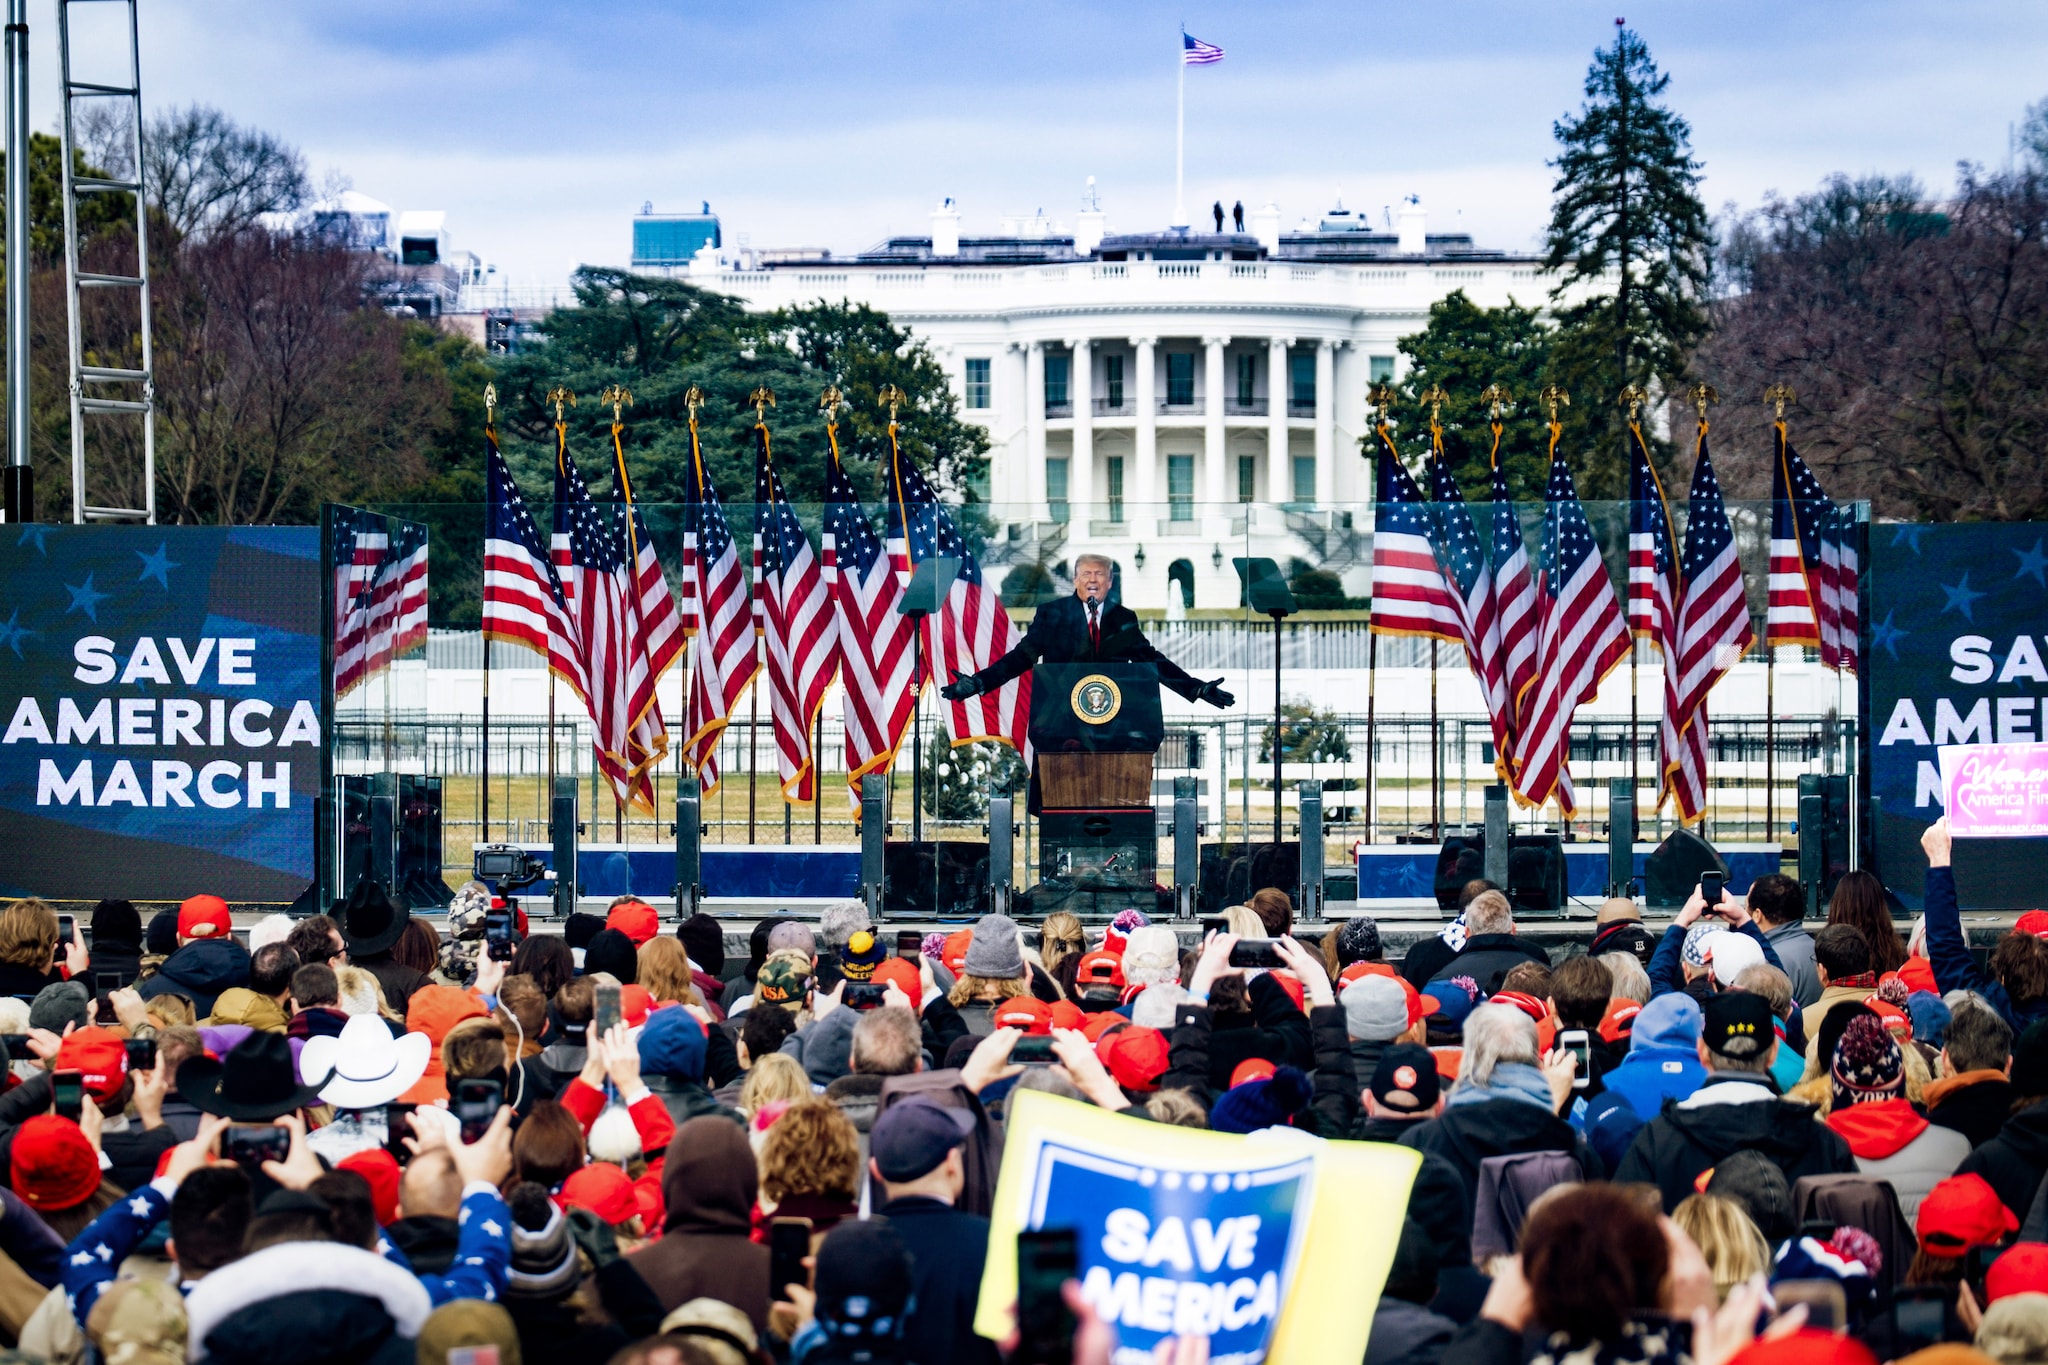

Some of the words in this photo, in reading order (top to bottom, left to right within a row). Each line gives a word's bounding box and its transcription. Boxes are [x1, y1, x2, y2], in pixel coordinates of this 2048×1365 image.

[73, 635, 256, 685] SAVE
[1950, 635, 2048, 684] SA
[2, 696, 321, 747] AMERICA
[1878, 697, 2048, 745] AME
[36, 758, 291, 809] MARCH
[1966, 790, 2024, 807] America
[762, 985, 789, 1000] USA
[1101, 1207, 1262, 1273] SAVE
[1080, 1265, 1278, 1335] MERICA
